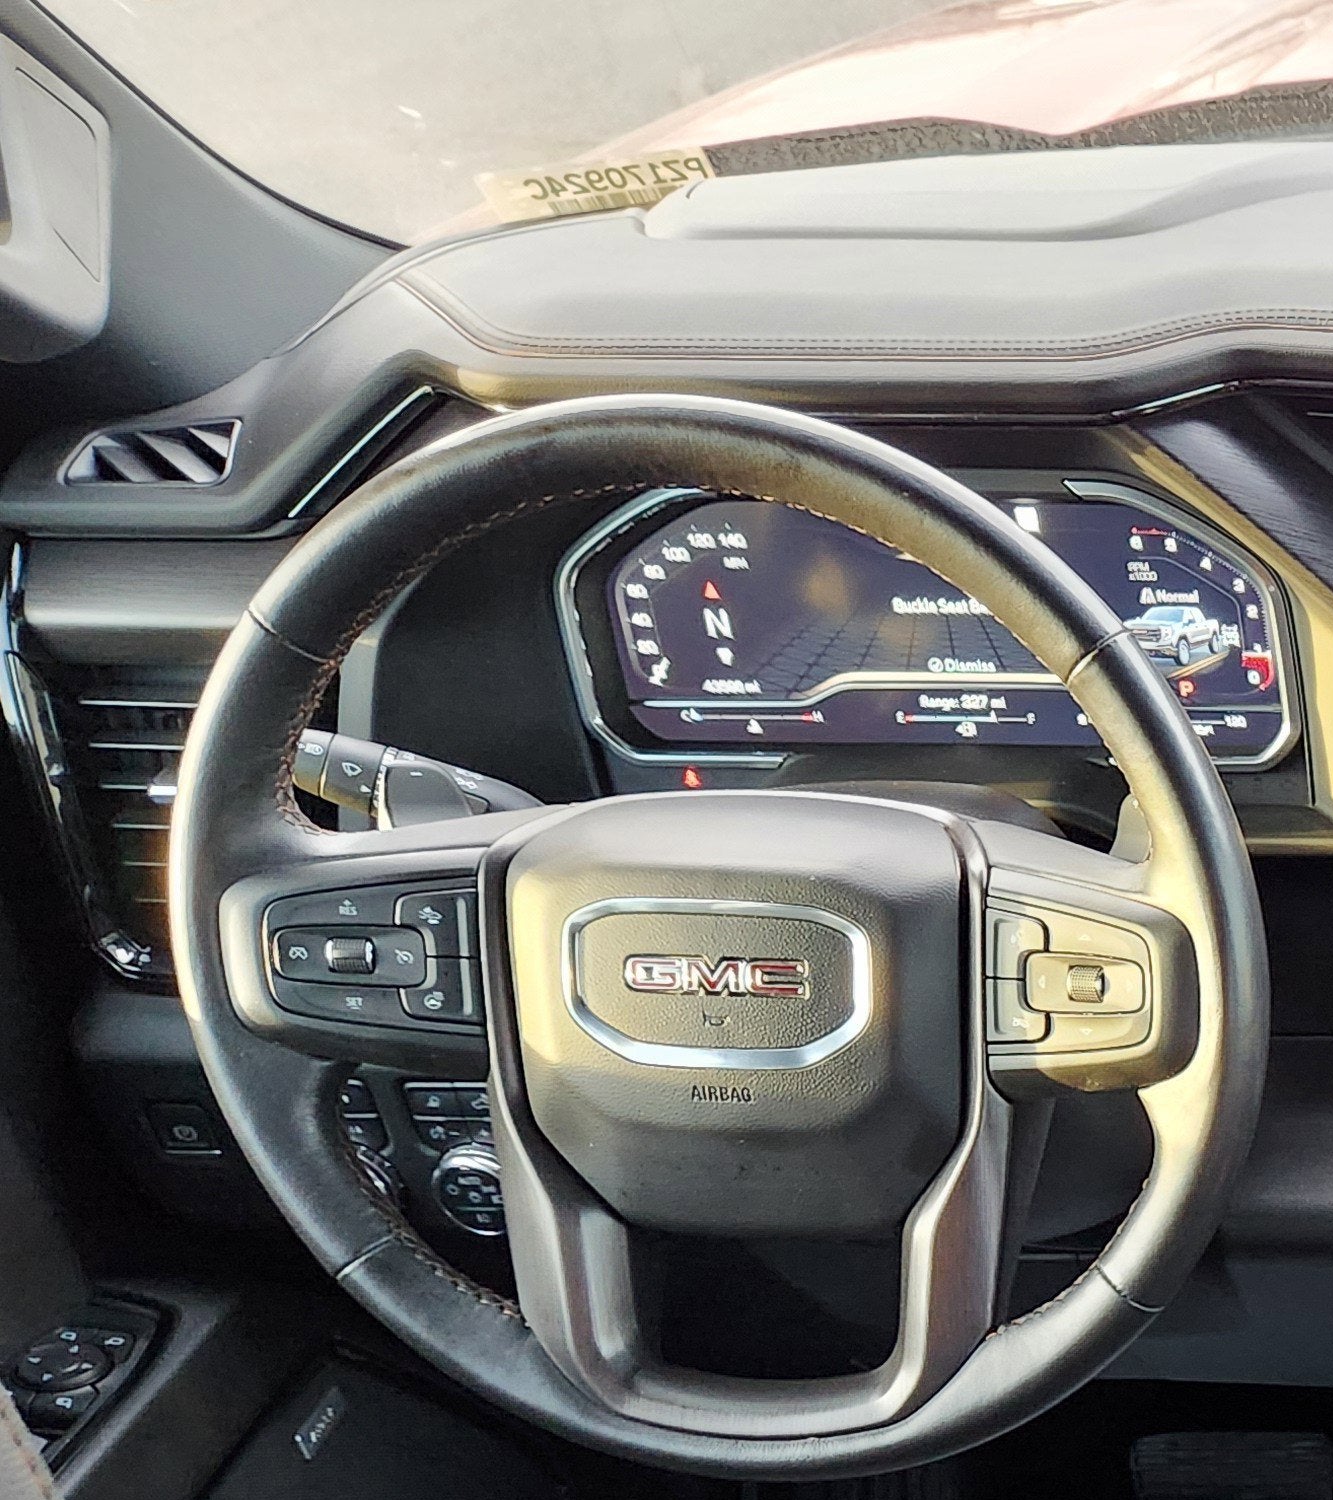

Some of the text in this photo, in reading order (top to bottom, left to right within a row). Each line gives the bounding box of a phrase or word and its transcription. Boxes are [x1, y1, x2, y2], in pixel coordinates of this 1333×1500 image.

[662, 546, 691, 563] 100
[1154, 588, 1200, 604] Normal
[937, 598, 969, 615] Seat
[702, 607, 735, 641] N
[943, 658, 997, 673] Dismiss
[1178, 679, 1195, 697] P
[624, 953, 810, 1000] GMC
[691, 1084, 752, 1103] AIRBAG
